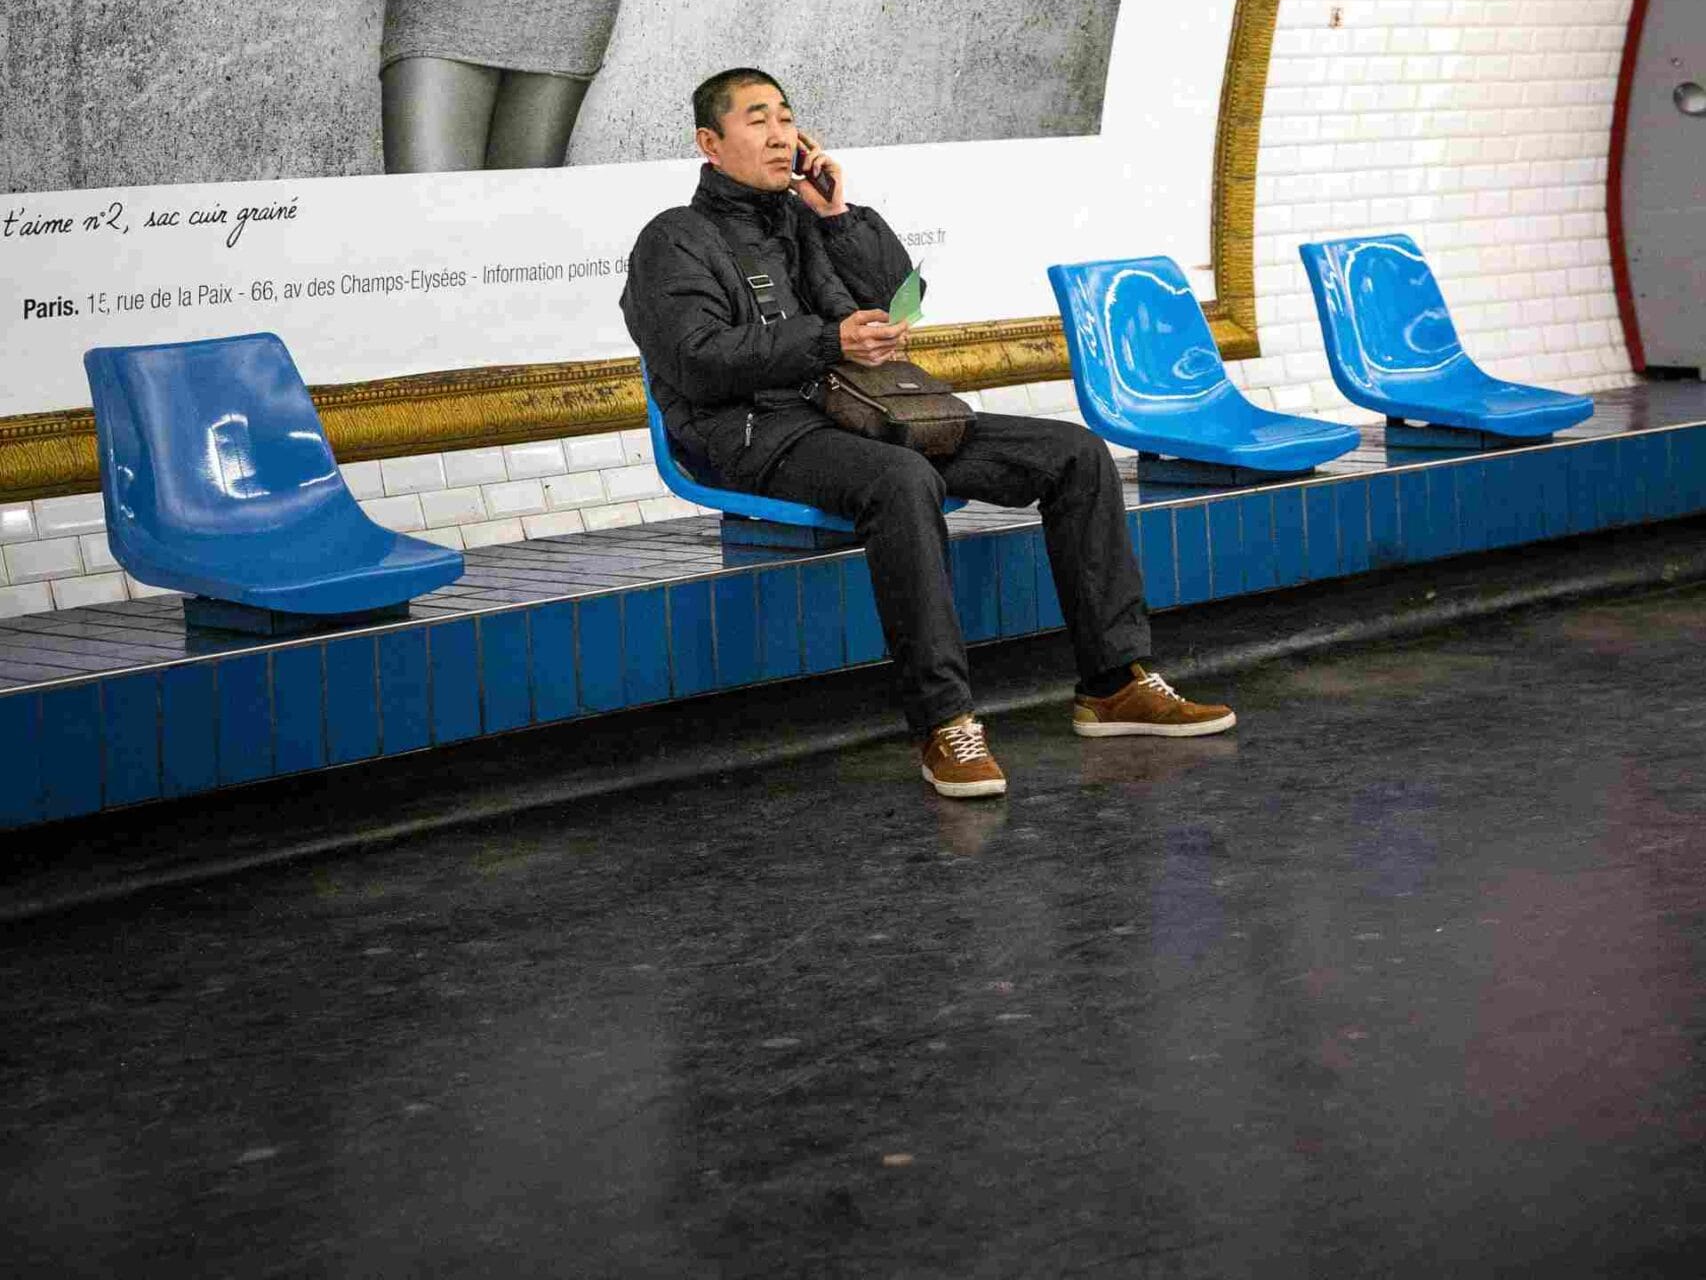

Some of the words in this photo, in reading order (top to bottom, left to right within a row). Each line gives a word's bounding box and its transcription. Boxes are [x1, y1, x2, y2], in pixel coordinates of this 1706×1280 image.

[3, 207, 73, 237] t'aime
[143, 211, 180, 227] sac
[188, 202, 228, 225] cuir
[225, 196, 298, 248] grainé
[23, 296, 79, 320] Paris.
[117, 293, 144, 314] rue
[150, 287, 172, 309] de
[178, 286, 192, 307] la
[198, 283, 233, 305] Paix
[251, 280, 278, 303] 66,
[283, 282, 302, 299] av
[307, 278, 335, 297] des
[341, 268, 467, 296] Champs-Elysées
[483, 261, 563, 285] Information
[568, 258, 611, 283] points
